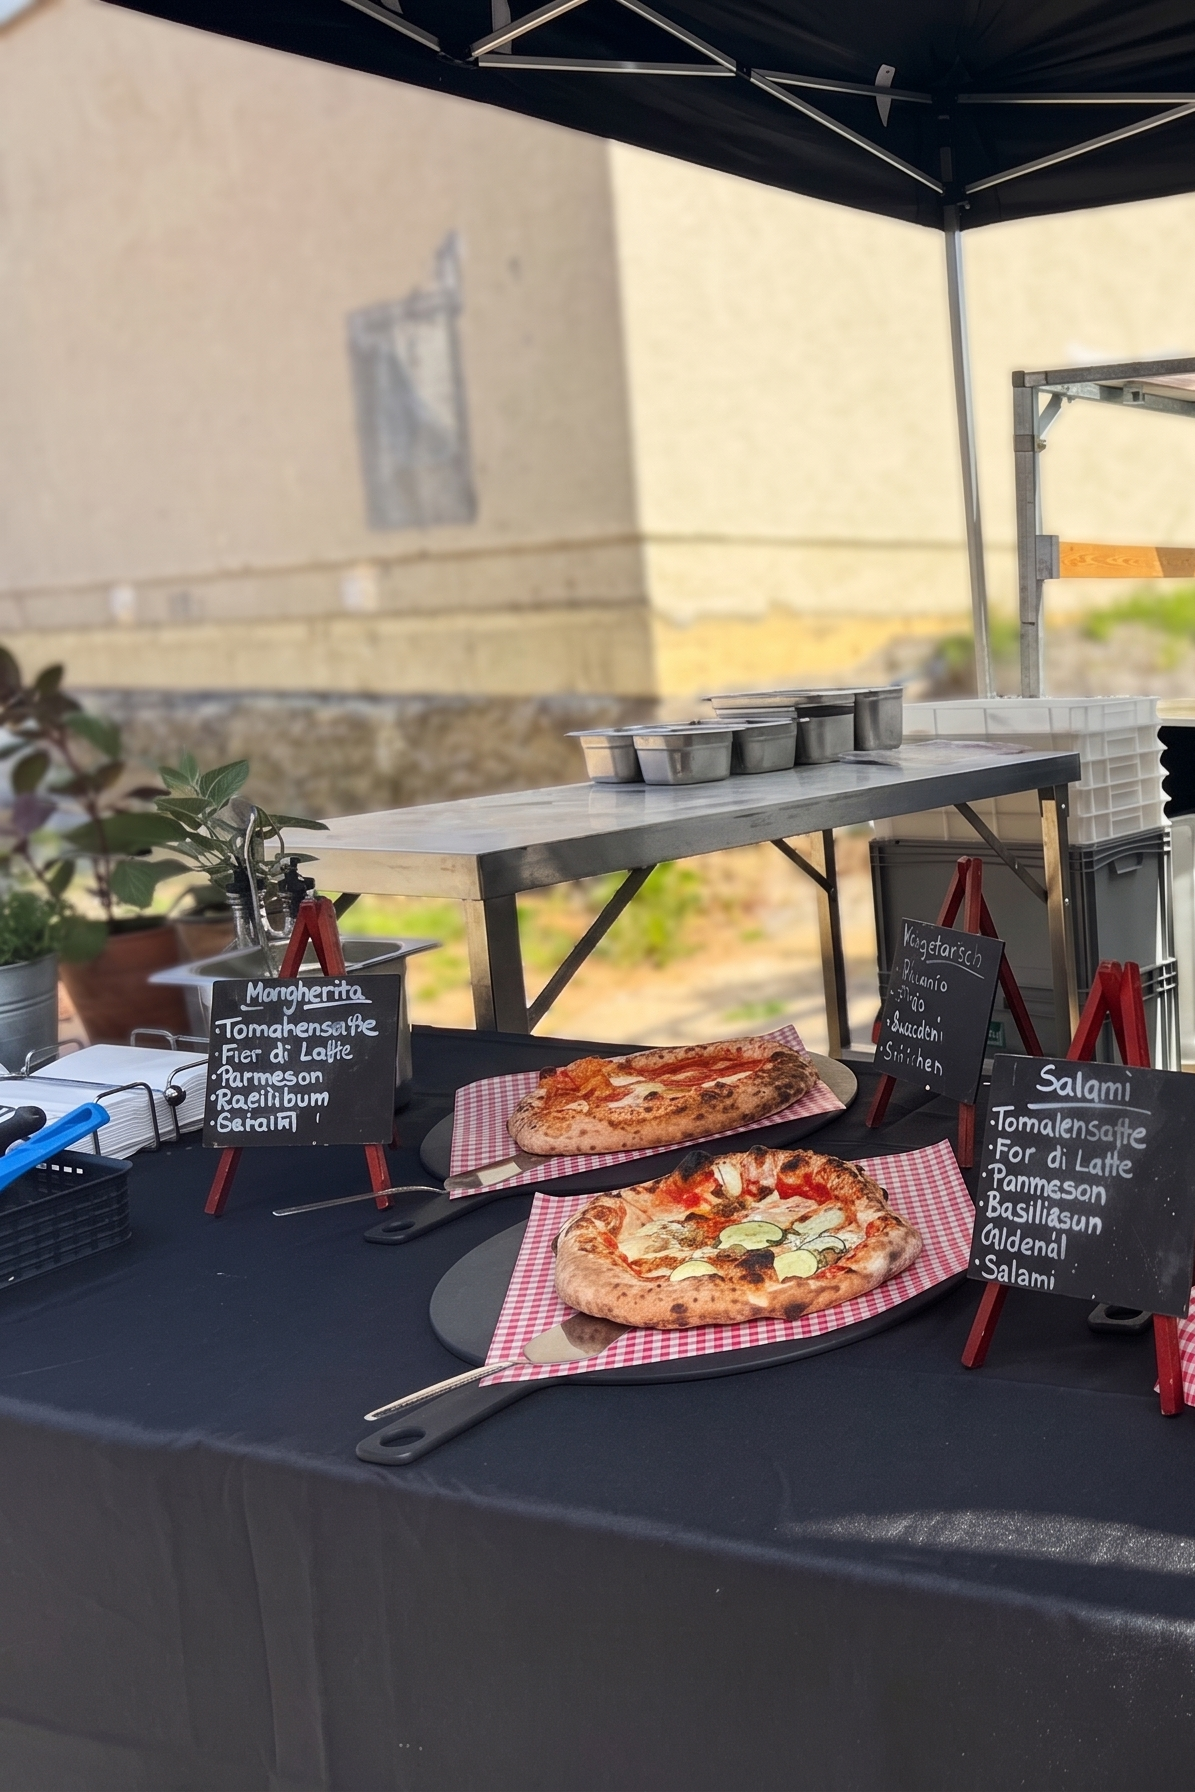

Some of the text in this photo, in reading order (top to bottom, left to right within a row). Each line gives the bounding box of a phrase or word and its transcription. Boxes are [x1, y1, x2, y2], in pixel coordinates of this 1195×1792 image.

[270, 1041, 291, 1064] di
[1036, 1064, 1133, 1103] Salami
[995, 1138, 1134, 1179] For di Latte
[981, 1254, 1055, 1290] Salami
